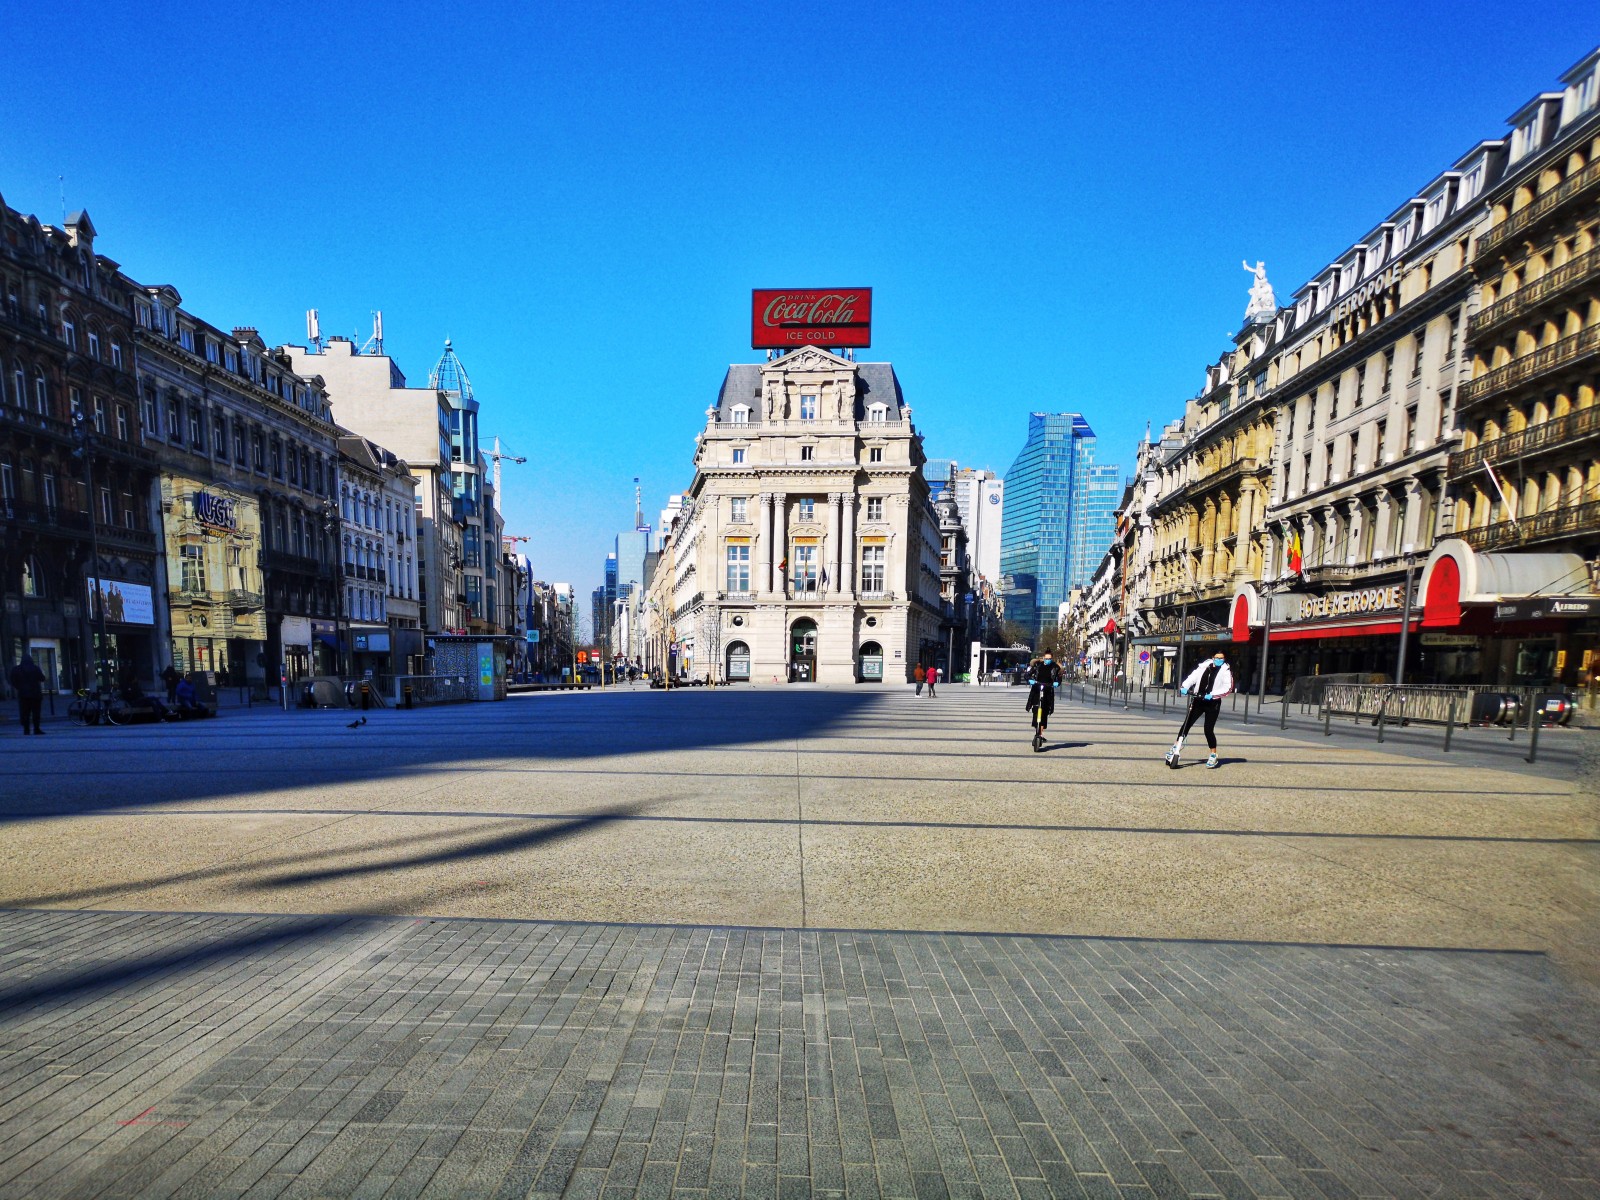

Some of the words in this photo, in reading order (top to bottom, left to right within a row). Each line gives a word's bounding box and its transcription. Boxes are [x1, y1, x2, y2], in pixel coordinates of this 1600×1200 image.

[763, 293, 860, 327] Coca-Cola
[1330, 262, 1402, 325] METROPOLE
[786, 332, 803, 340] ICE
[806, 331, 836, 340] COLD
[1299, 597, 1328, 620] HOTEL
[1331, 586, 1400, 617] METROPOLE
